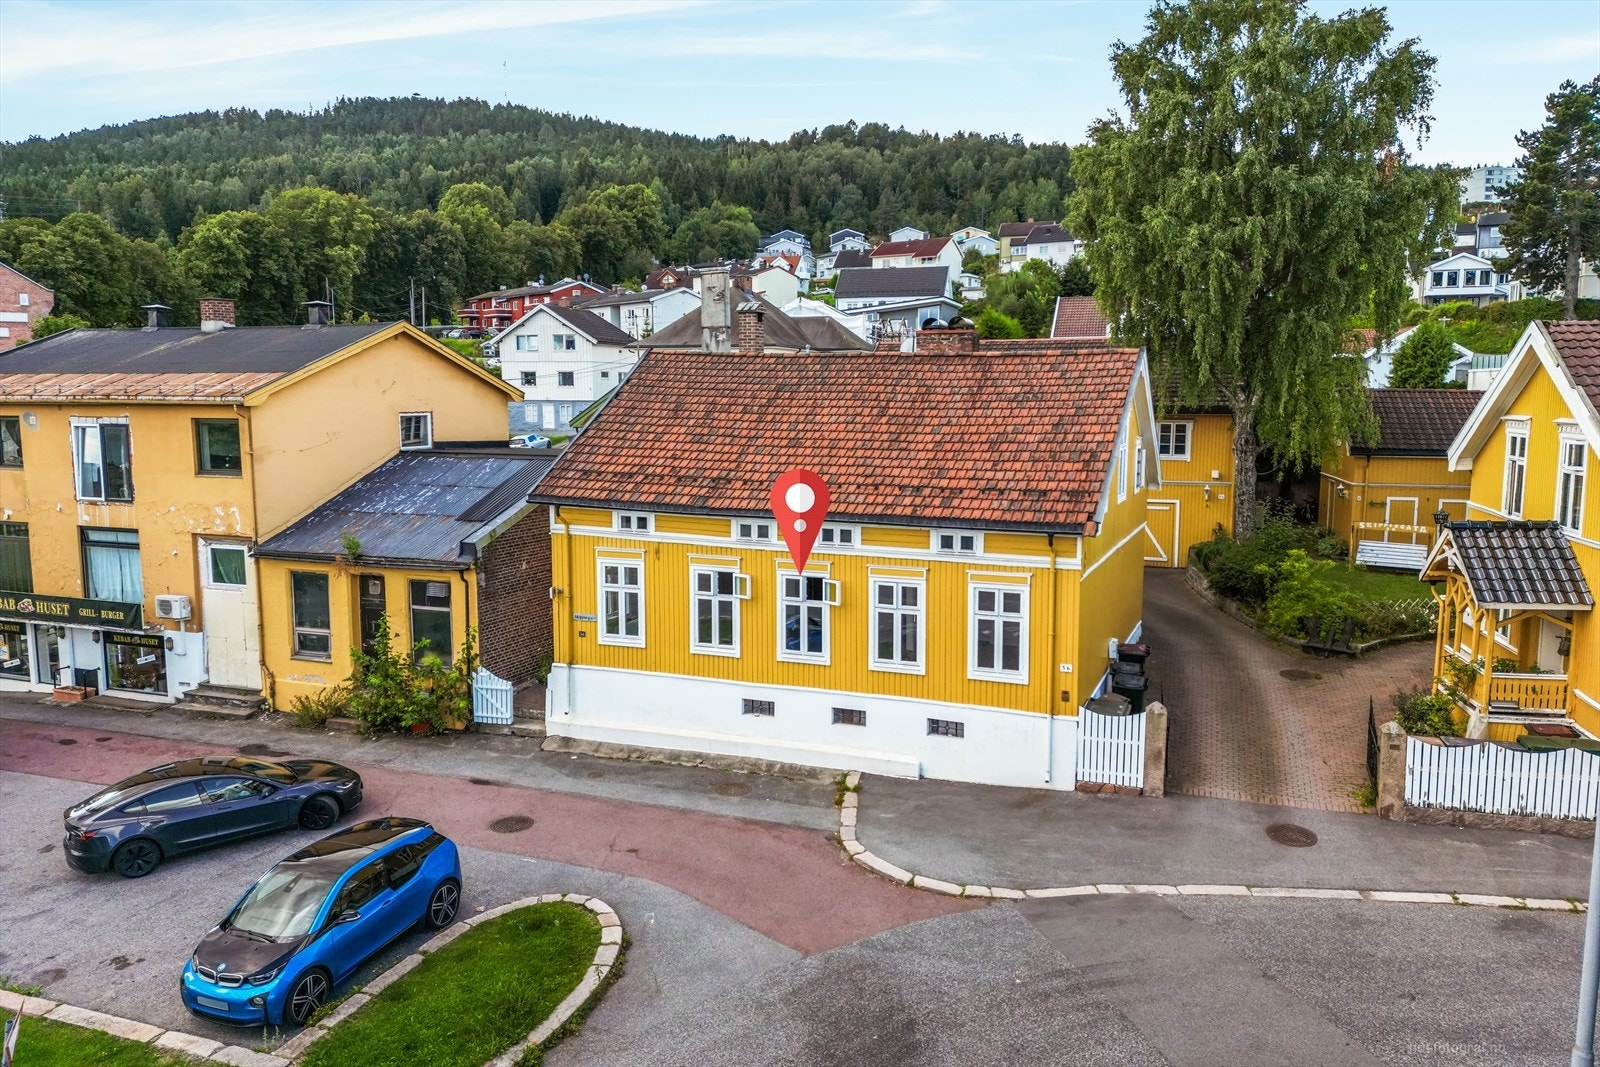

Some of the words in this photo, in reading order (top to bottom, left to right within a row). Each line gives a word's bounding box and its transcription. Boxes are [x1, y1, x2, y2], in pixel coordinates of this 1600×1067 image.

[35, 601, 70, 616] HUSET
[101, 610, 124, 620] BURGER
[113, 635, 131, 643] KEBAB
[141, 637, 159, 645] HUSET
